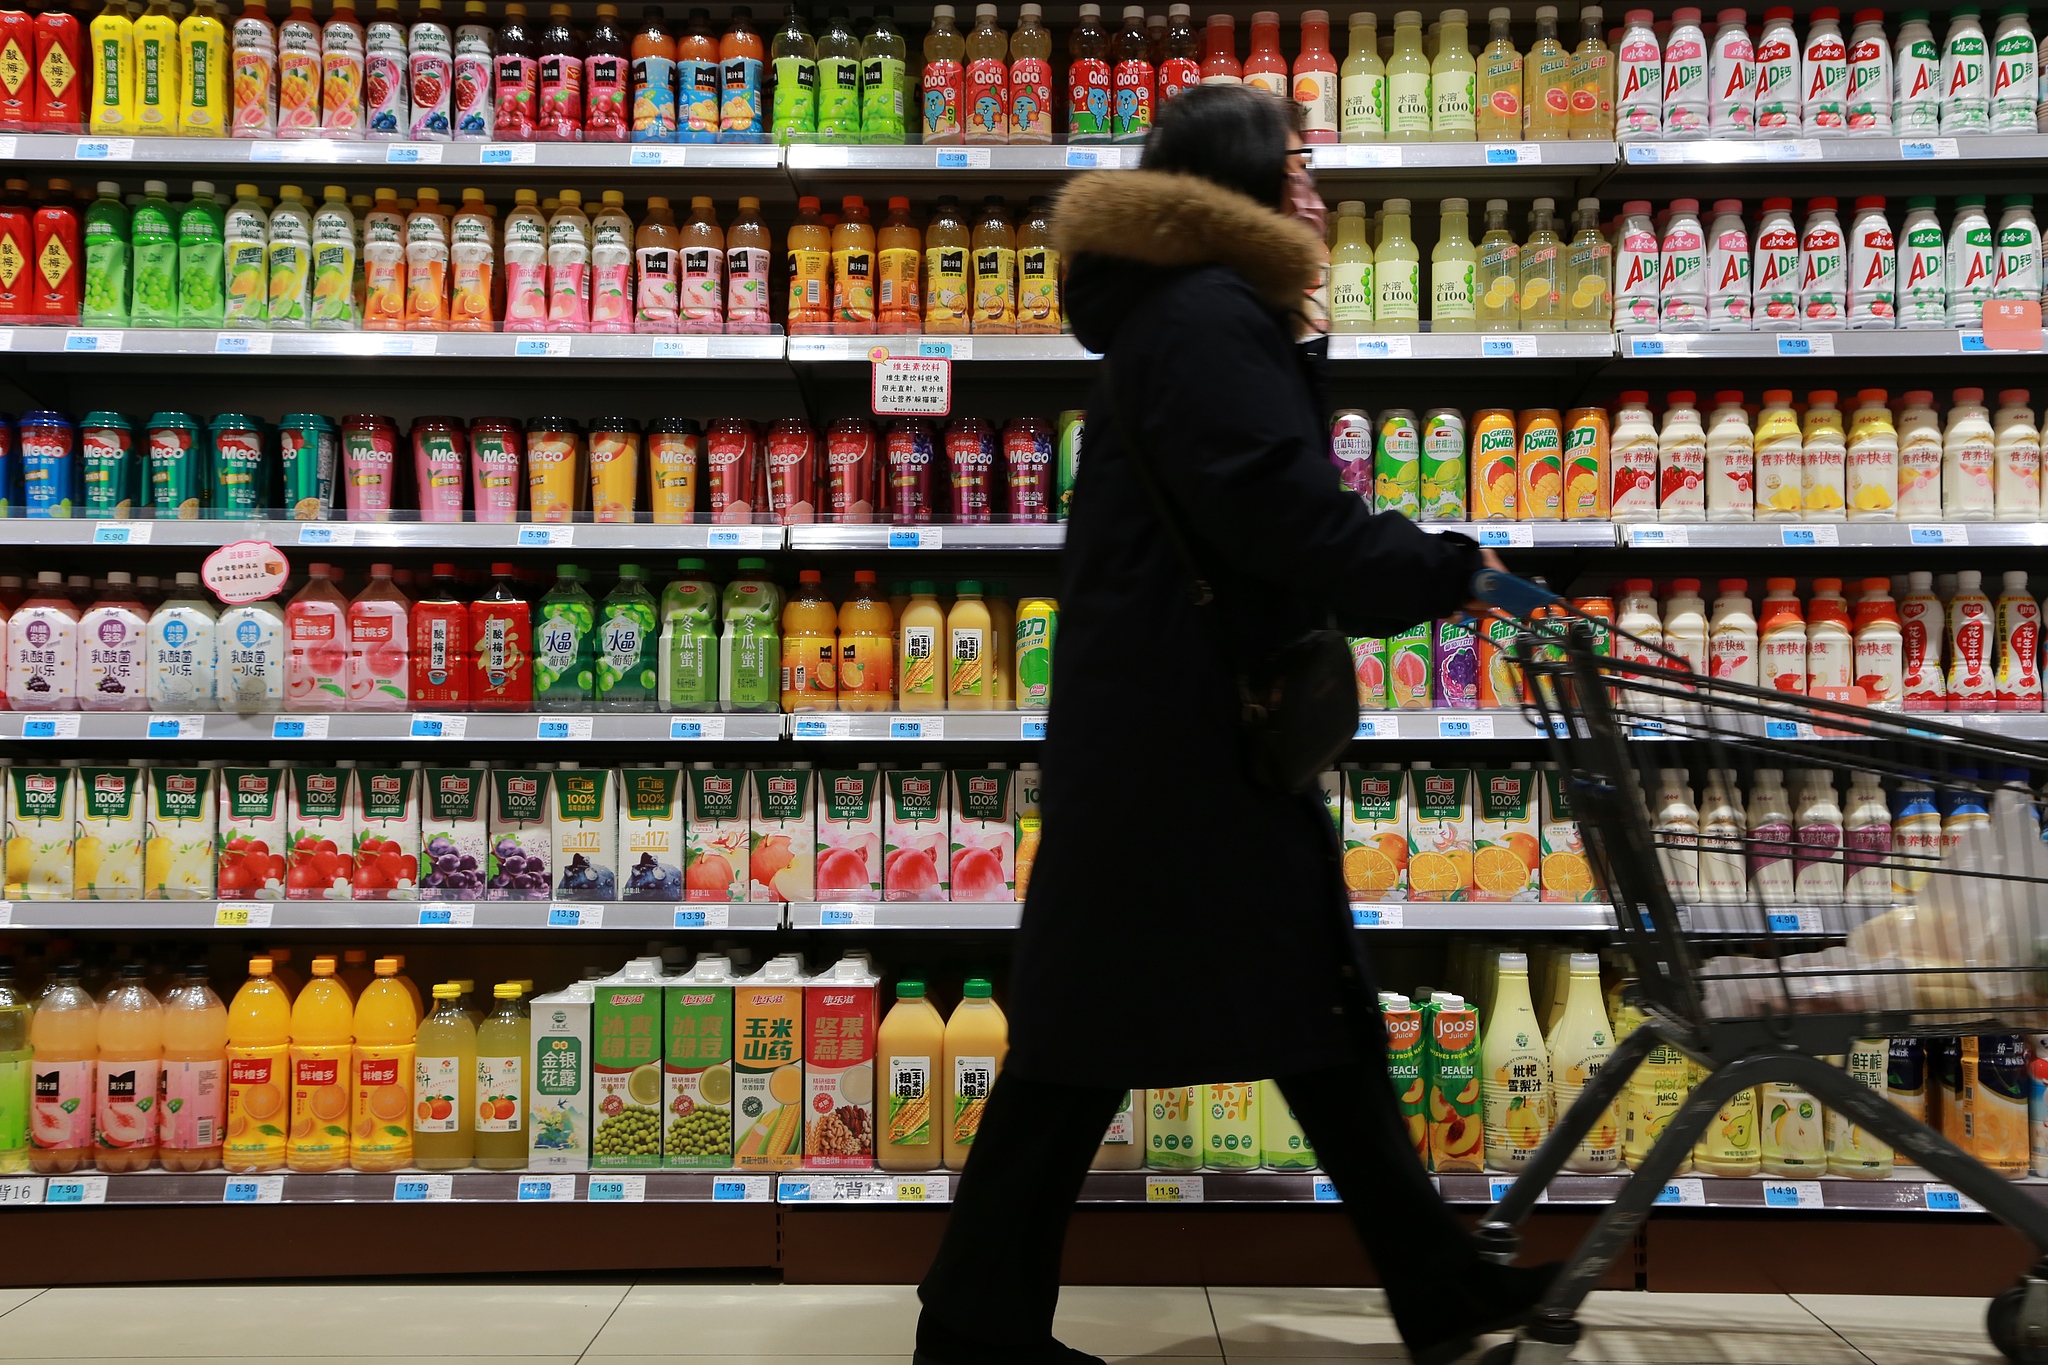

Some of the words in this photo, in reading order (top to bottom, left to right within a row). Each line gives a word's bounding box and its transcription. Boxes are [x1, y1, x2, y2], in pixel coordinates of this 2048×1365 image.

[413, 31, 446, 42] Tropicana
[106, 44, 117, 99] 冰糖雪梨
[146, 44, 158, 99] 冰糖雪梨
[194, 46, 205, 101] 冰糖雪梨
[1345, 95, 1363, 106] 水溶
[1910, 142, 1932, 150] 4.90
[397, 149, 418, 157] 3.50
[490, 149, 510, 157] 3.90
[640, 151, 660, 159] 3.90
[1495, 148, 1516, 156] 3.90
[945, 154, 966, 162] 3.90
[270, 217, 299, 229] Tropicana
[317, 218, 347, 229] Tropicana
[47, 243, 60, 280] 酸梅汤
[1661, 254, 1701, 293] AD钙
[1334, 283, 1352, 294] 水溶
[1382, 281, 1402, 292] 水溶
[1436, 282, 1455, 293] 水溶
[1999, 305, 2024, 315] 缺货
[76, 337, 98, 345] 3.50
[224, 338, 245, 346] 3.50
[530, 341, 550, 349] 3.50
[663, 342, 684, 350] 3.90
[1491, 342, 1512, 350] 3.90
[1641, 342, 1662, 350] 4.90
[1786, 340, 1807, 348] 4.90
[926, 346, 946, 354] 3.90
[893, 361, 940, 372] 维生素饮料
[886, 374, 941, 383] 维生素饮料避免
[1490, 428, 1514, 438] GREEN
[1532, 428, 1557, 438] GREEN
[1481, 434, 1515, 454] POWER
[1524, 434, 1558, 454] POWER
[890, 451, 929, 465] Meco
[954, 451, 993, 465] Meco
[1009, 450, 1049, 464] Meco
[1902, 452, 1940, 465] 营养快线
[103, 533, 124, 542] 5.90
[309, 529, 330, 537] 5.90
[528, 531, 548, 539] 5.90
[717, 533, 738, 541] 5.90
[896, 531, 916, 540] 5.90
[1487, 531, 1508, 539] 5.90
[1643, 530, 1664, 538] 4.90
[1793, 531, 1814, 539] 4.50
[1921, 529, 1942, 537] 4.90
[295, 617, 311, 626] 统一
[295, 625, 332, 637] 蜜桃多
[353, 626, 390, 638] 蜜桃多
[433, 628, 445, 666] 酸梅汤
[492, 628, 503, 666] 酸梅汤
[545, 632, 572, 654] 水晶
[607, 632, 636, 653] 水晶
[680, 615, 695, 670] 冬瓜蜜
[741, 615, 756, 669] 冬瓜蜜
[1908, 626, 1921, 668] 花生牛奶
[1967, 626, 1980, 668] 花生牛奶
[2021, 627, 2034, 668] 花生牛奶
[20, 650, 56, 665] 乳酸菌
[91, 650, 131, 665] 乳酸菌
[158, 650, 192, 665] 乳酸菌
[548, 655, 570, 667] 葡萄
[611, 654, 633, 667] 葡萄
[31, 664, 56, 677] 水乐
[103, 664, 131, 677] 水乐
[168, 664, 192, 677] 水乐
[1825, 691, 1850, 701] 缺货
[680, 723, 701, 731] 6.90
[805, 721, 825, 730] 5.90
[899, 723, 919, 731] 6.90
[1448, 722, 1468, 731] 6.90
[1776, 723, 1797, 731] 4.50
[25, 793, 57, 805] 100%
[834, 795, 864, 807] 100%
[902, 795, 932, 807] 100%
[1361, 796, 1391, 807] 100%
[1490, 795, 1521, 806] 100%
[1368, 810, 1383, 818] 橙汁
[222, 911, 248, 920] 11.90
[426, 911, 452, 919] 13.90
[555, 909, 581, 918] 13.90
[681, 911, 706, 920] 13.90
[828, 910, 854, 919] 13.90
[1357, 910, 1383, 919] 13.90
[1775, 915, 1797, 924] 4.90
[611, 993, 645, 1006] 康乐滋
[822, 993, 856, 1006] 康乐滋
[602, 1015, 653, 1036] 冰爽
[672, 1015, 724, 1036] 冰爽
[743, 1018, 793, 1039] 玉米
[813, 1017, 864, 1038] 坚果
[1394, 1031, 1414, 1039] Juice
[1449, 1031, 1469, 1039] Juice
[601, 1037, 652, 1059] 绿豆
[671, 1037, 723, 1059] 绿豆
[742, 1040, 793, 1061] 山药
[812, 1039, 864, 1060] 燕麦
[541, 1052, 577, 1068] 金银
[1649, 1047, 1683, 1065] 雪梨
[1852, 1052, 1882, 1070] 鲜榨
[232, 1067, 268, 1080] 鲜橙多
[299, 1069, 335, 1082] 鲜橙多
[362, 1069, 395, 1082] 鲜橙多
[1386, 1065, 1419, 1075] PEACH
[1441, 1065, 1474, 1075] PEACH
[1513, 1064, 1538, 1078] 枇杷
[541, 1069, 577, 1088] 花露
[37, 1081, 58, 1091] 美汁源
[899, 1071, 912, 1098] 粗粮
[912, 1071, 921, 1097] 玉米浆
[963, 1071, 976, 1098] 粗粮
[976, 1071, 986, 1097] 玉米浆
[1507, 1079, 1542, 1093] 雪梨汁
[1656, 1092, 1678, 1107] juice
[1732, 1092, 1751, 1107] juice
[57, 1185, 78, 1194] 7.90
[235, 1185, 256, 1193] 6.90
[403, 1183, 429, 1192] 17.90
[596, 1184, 622, 1193] 14.90
[720, 1183, 746, 1192] 17.90
[901, 1186, 922, 1195] 9.90
[1154, 1186, 1180, 1195] 11.90
[1771, 1186, 1798, 1195] 14.90
[1932, 1192, 1959, 1202] 11.90
